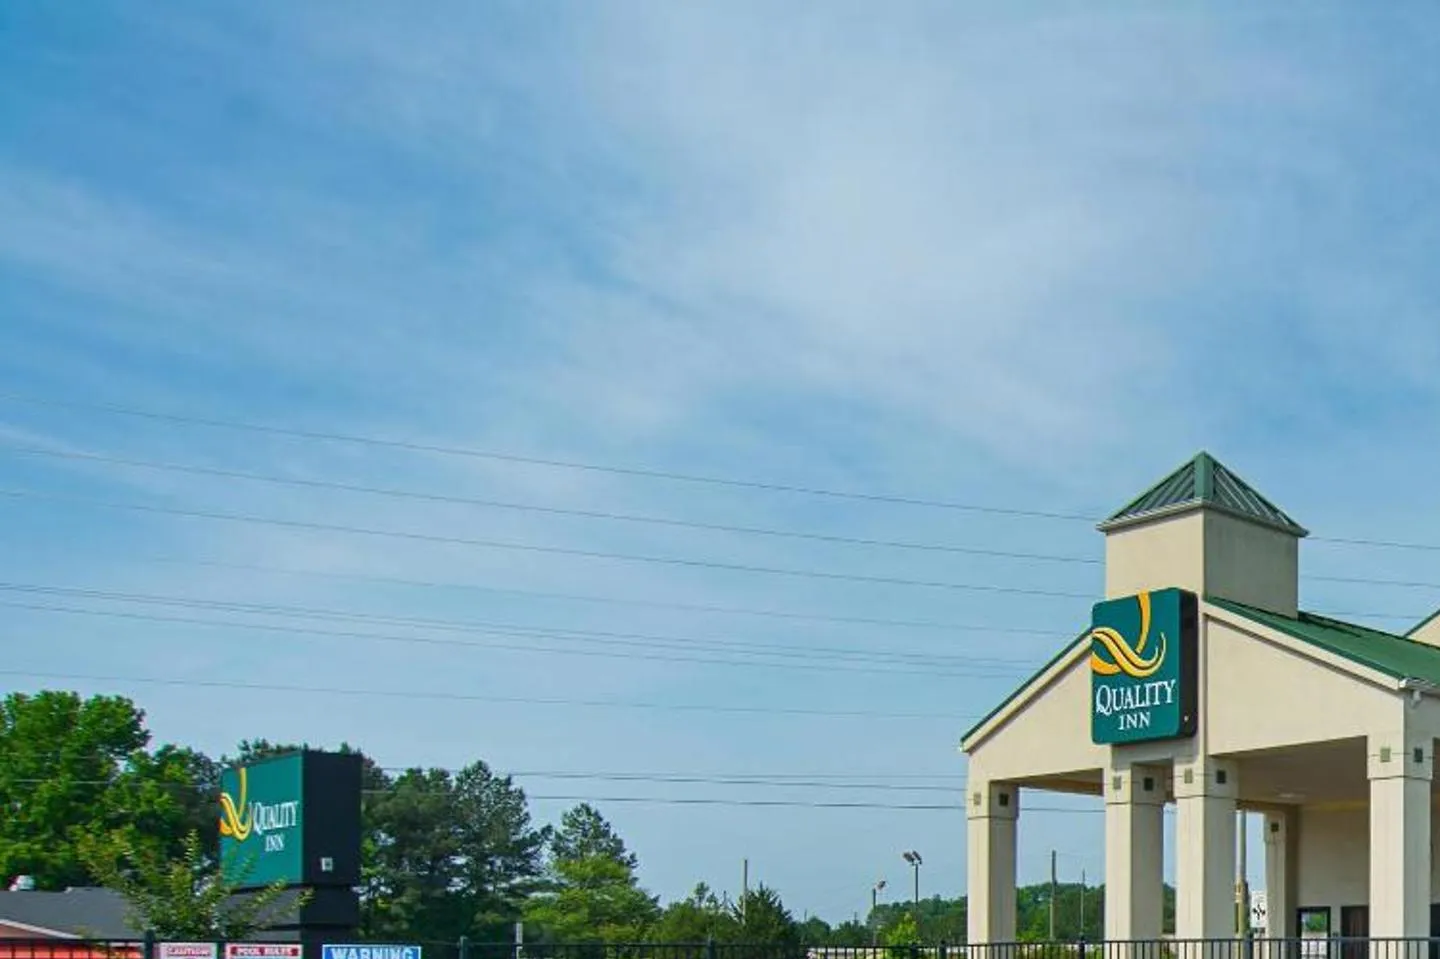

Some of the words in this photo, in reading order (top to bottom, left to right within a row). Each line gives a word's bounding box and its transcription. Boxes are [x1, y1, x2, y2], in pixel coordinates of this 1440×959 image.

[1095, 680, 1176, 715] QUALITY
[1118, 711, 1151, 730] INN
[253, 800, 300, 835] QUALITY
[264, 833, 285, 852] INN
